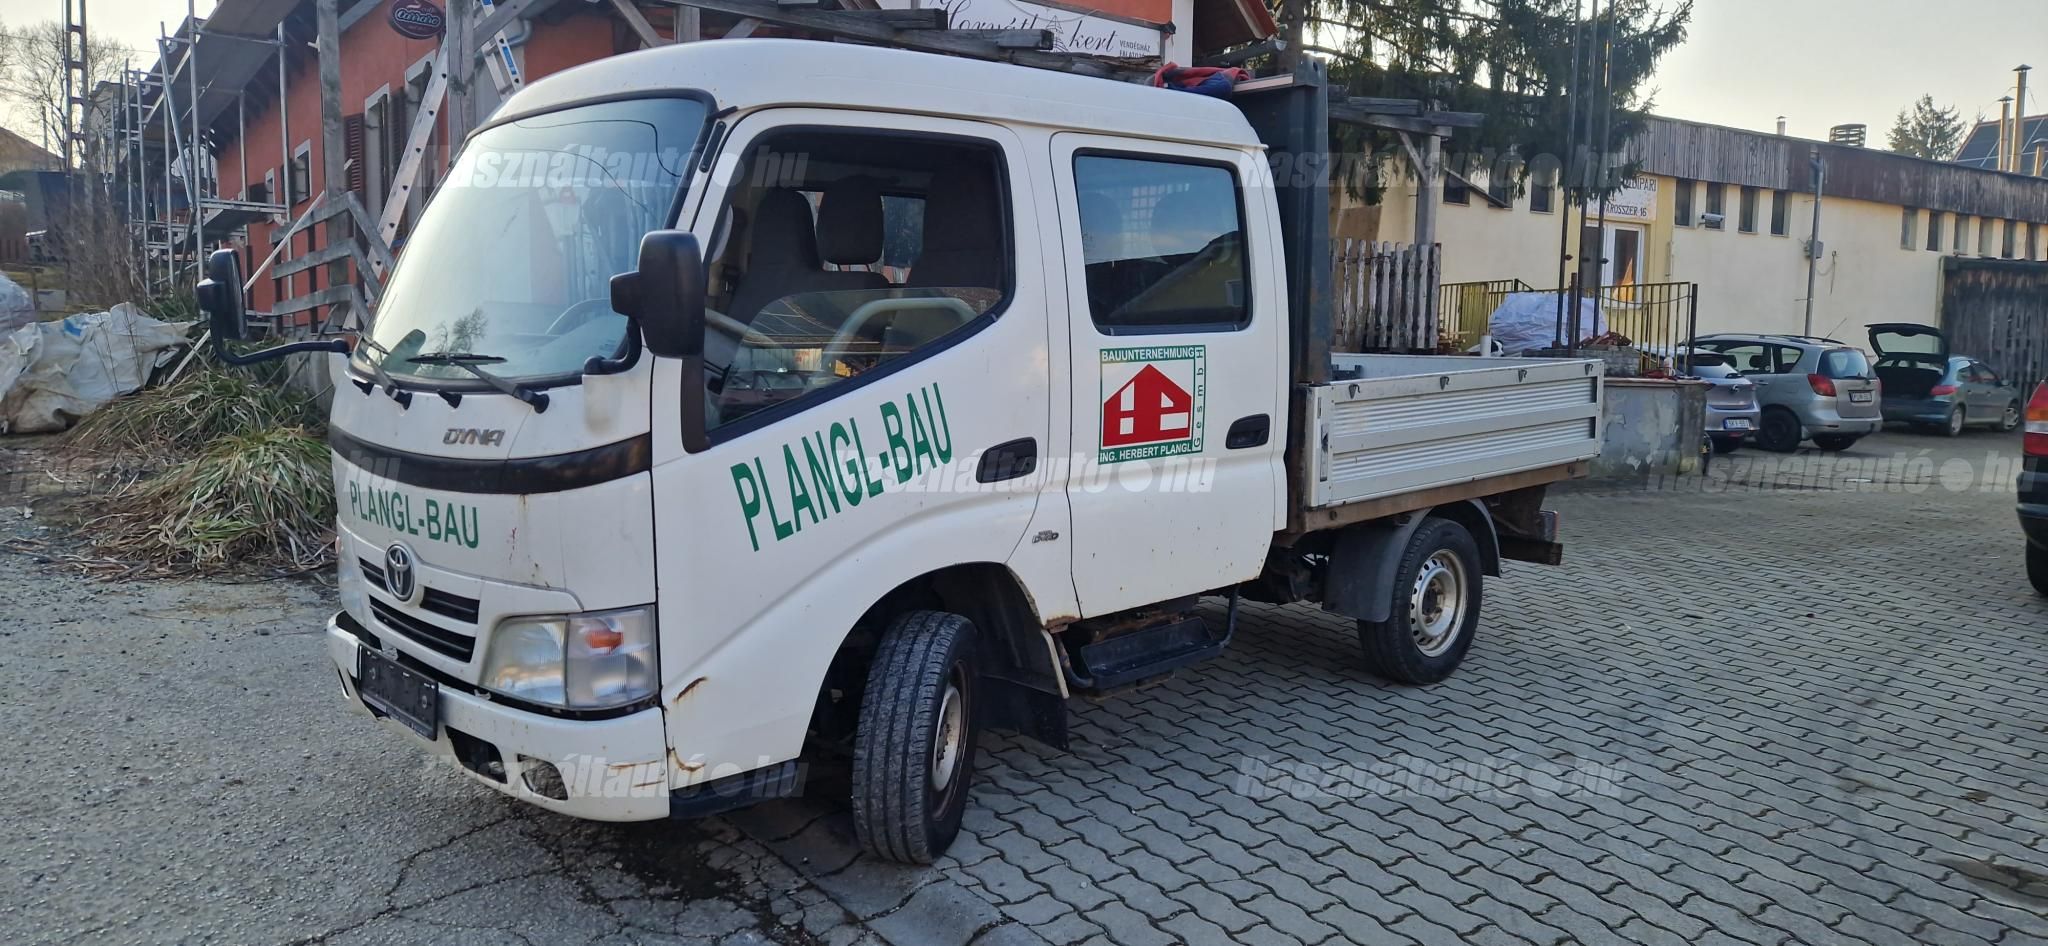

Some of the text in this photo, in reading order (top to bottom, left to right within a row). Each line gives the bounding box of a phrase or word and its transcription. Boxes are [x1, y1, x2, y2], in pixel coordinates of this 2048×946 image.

[1102, 346, 1195, 361] BAUUNTERNEHMUNG
[442, 428, 505, 447] DYNA
[1099, 443, 1192, 464] ING. HERBERT PLANGL
[730, 382, 952, 552] PLANGL-BAU
[349, 479, 479, 549] PLANGL-BAU
